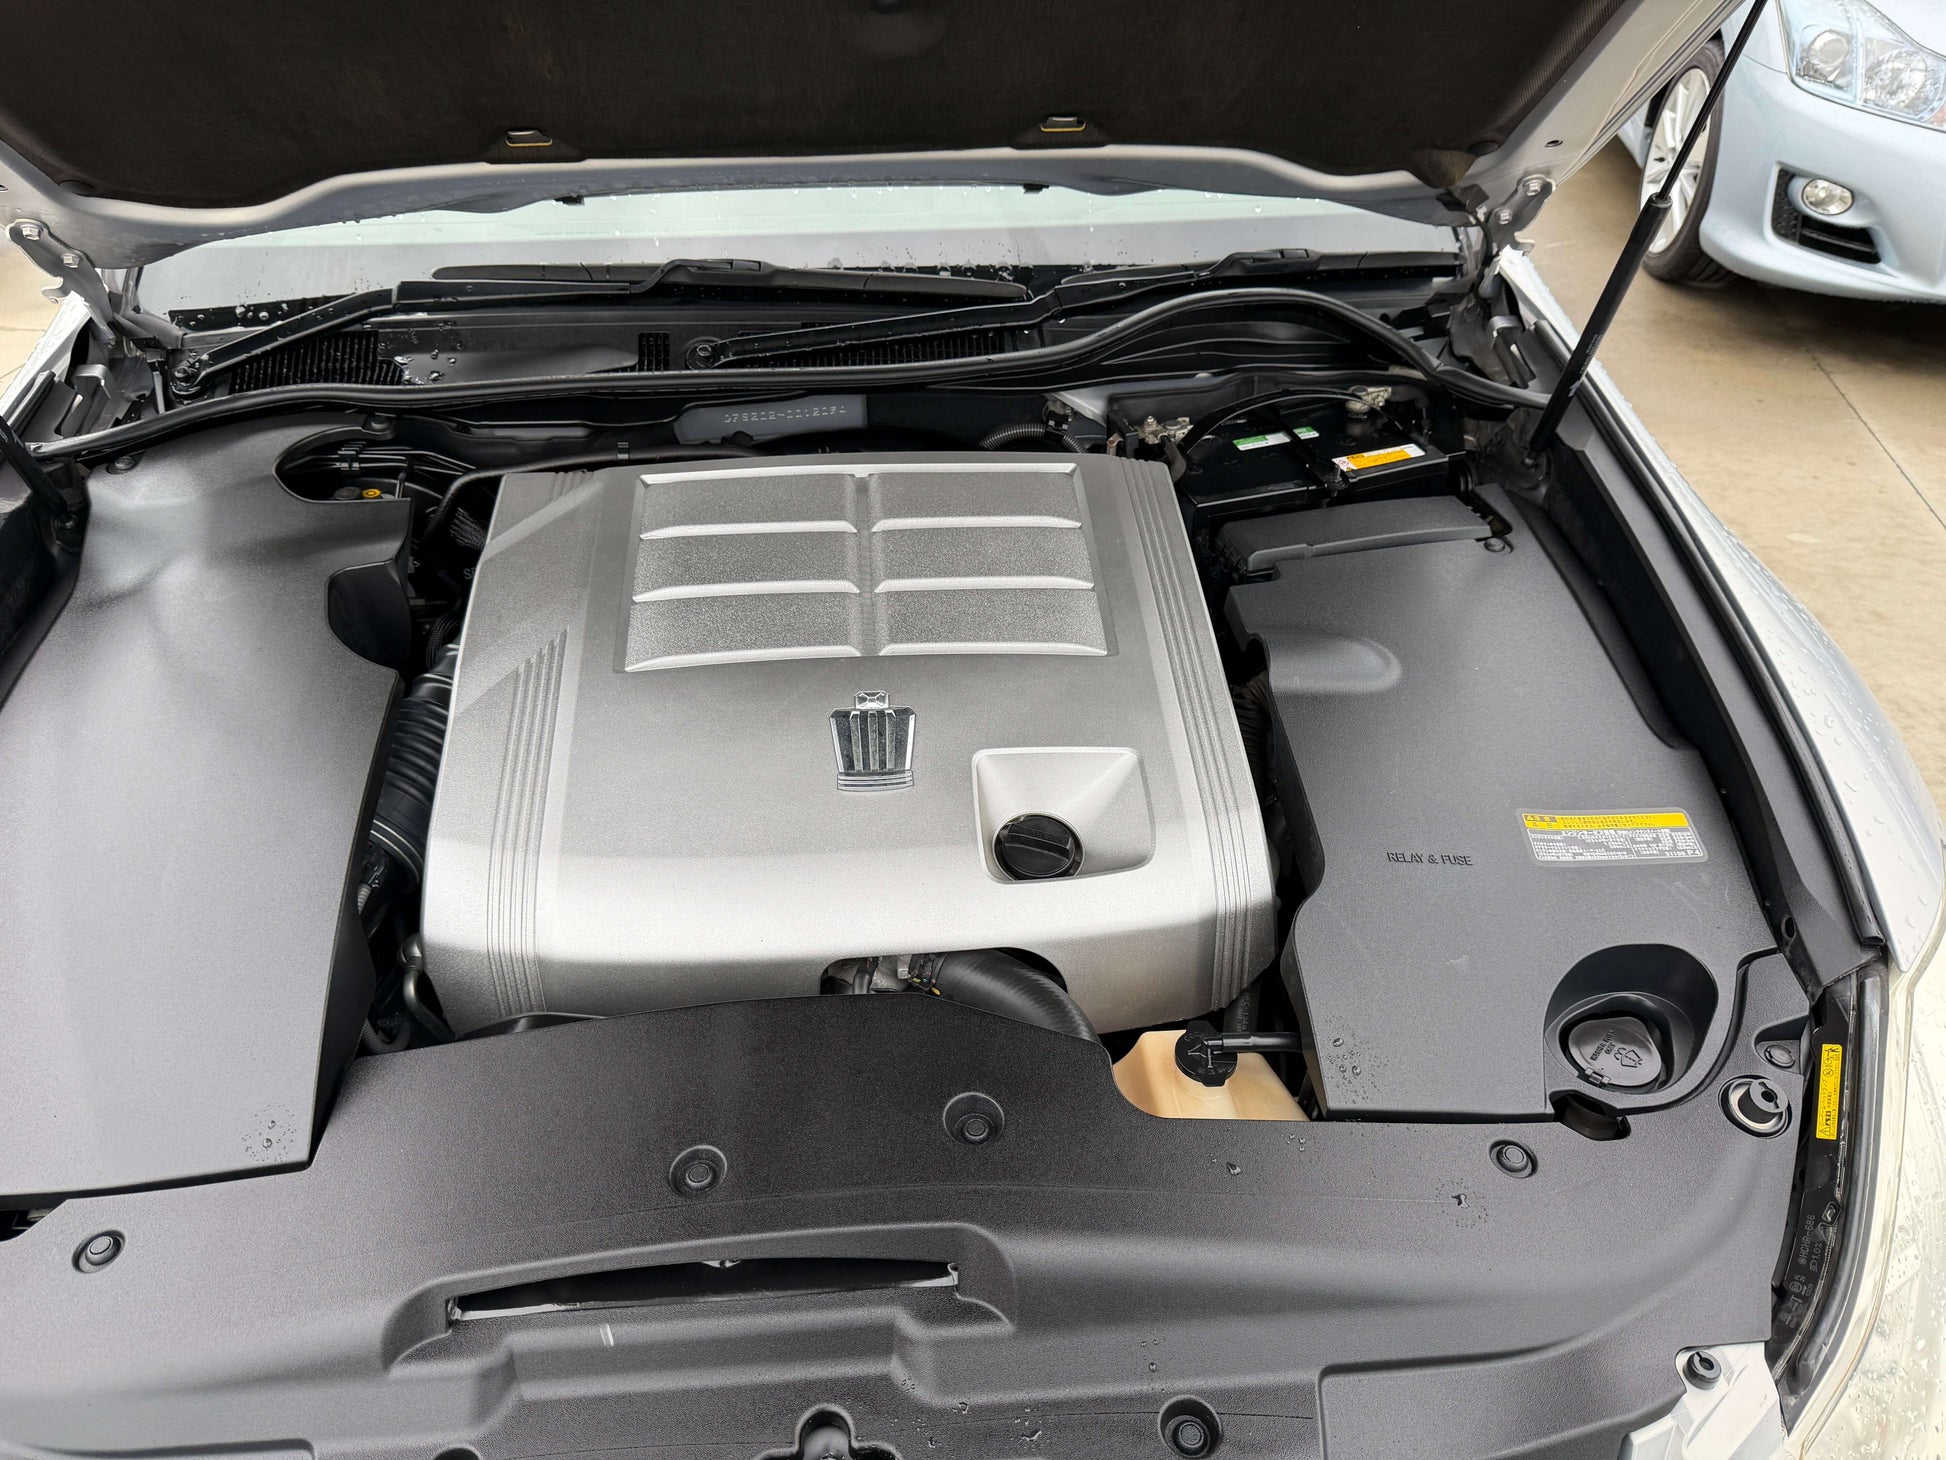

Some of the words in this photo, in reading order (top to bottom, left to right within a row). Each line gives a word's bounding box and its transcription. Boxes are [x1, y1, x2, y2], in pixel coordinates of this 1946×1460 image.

[1386, 851, 1424, 864] RELAY
[1427, 853, 1439, 865] &
[1440, 854, 1474, 867] FUSE
